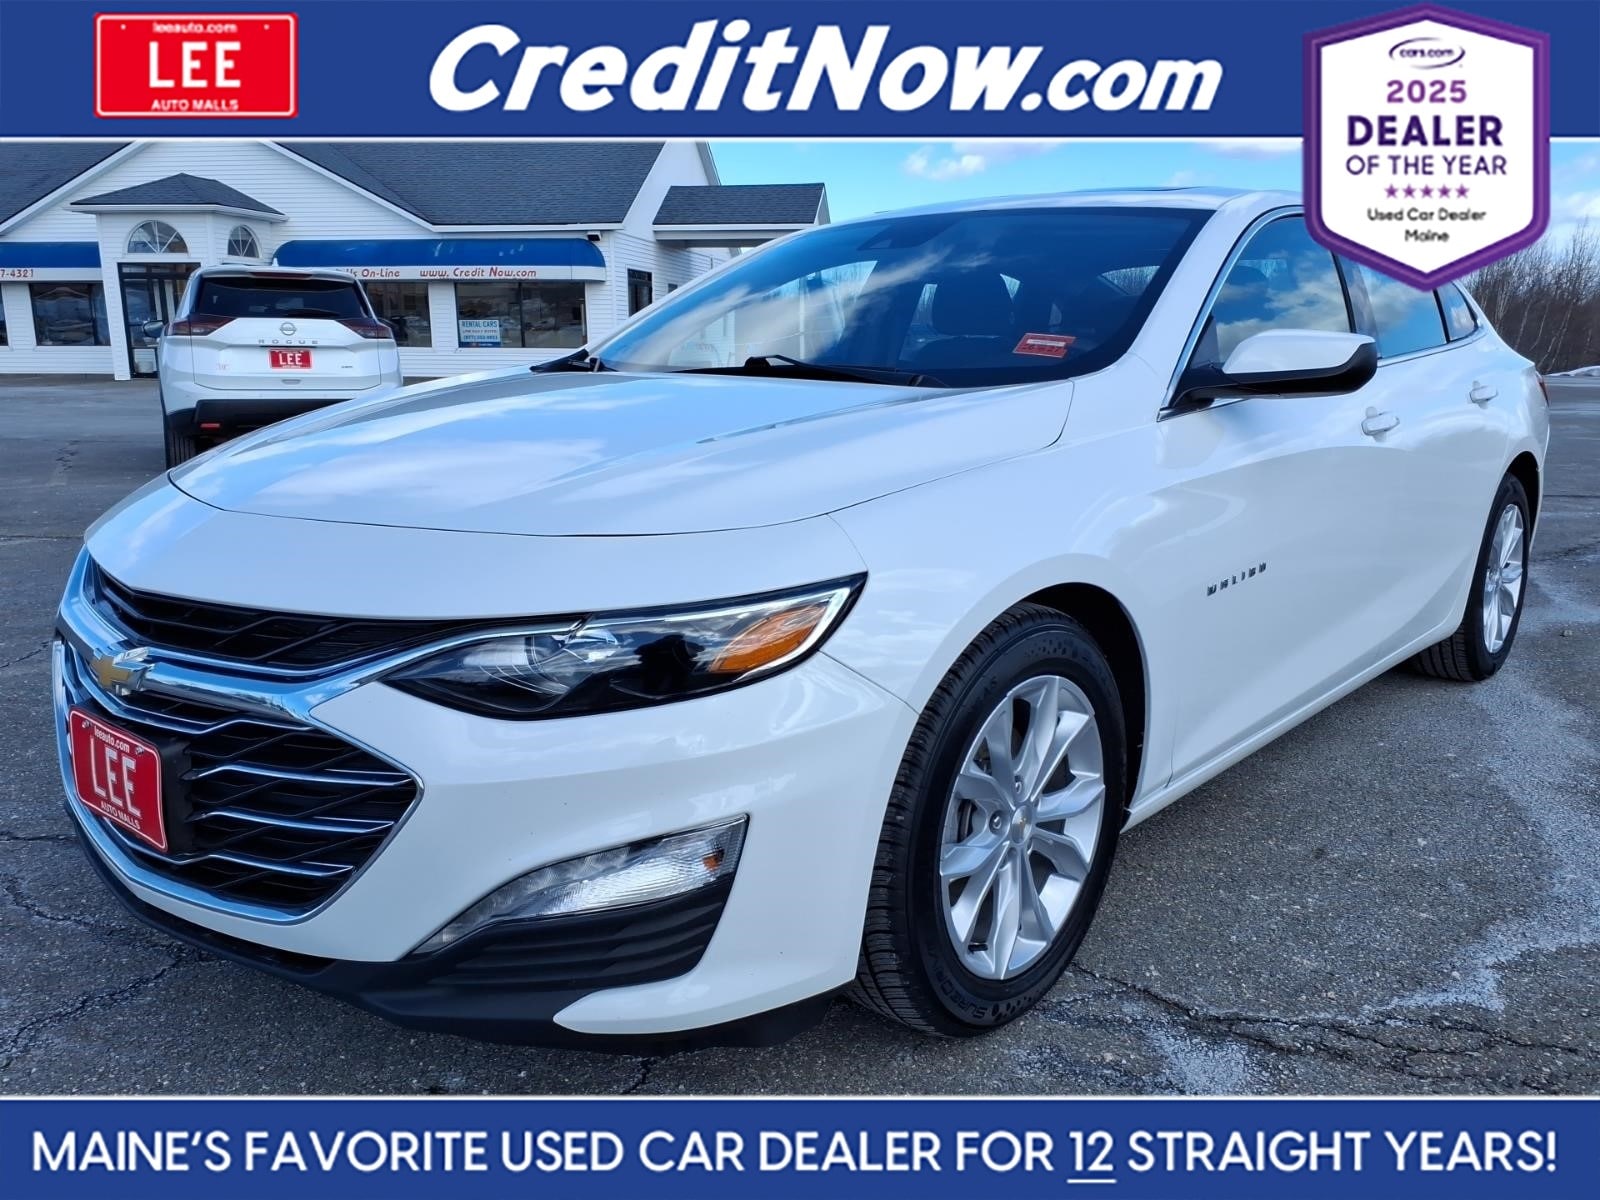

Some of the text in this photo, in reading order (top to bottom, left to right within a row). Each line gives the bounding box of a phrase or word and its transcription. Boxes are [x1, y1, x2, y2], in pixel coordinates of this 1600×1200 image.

[361, 267, 400, 278] On-Line
[420, 269, 449, 278] www.
[453, 267, 485, 277] Credit
[488, 266, 537, 278] Now.com
[462, 320, 498, 328] RENTAL CARS
[279, 353, 303, 365] LEE
[94, 725, 130, 754] leeauto.com
[90, 735, 142, 819] LEE
[101, 801, 141, 830] AUTO MALLS
